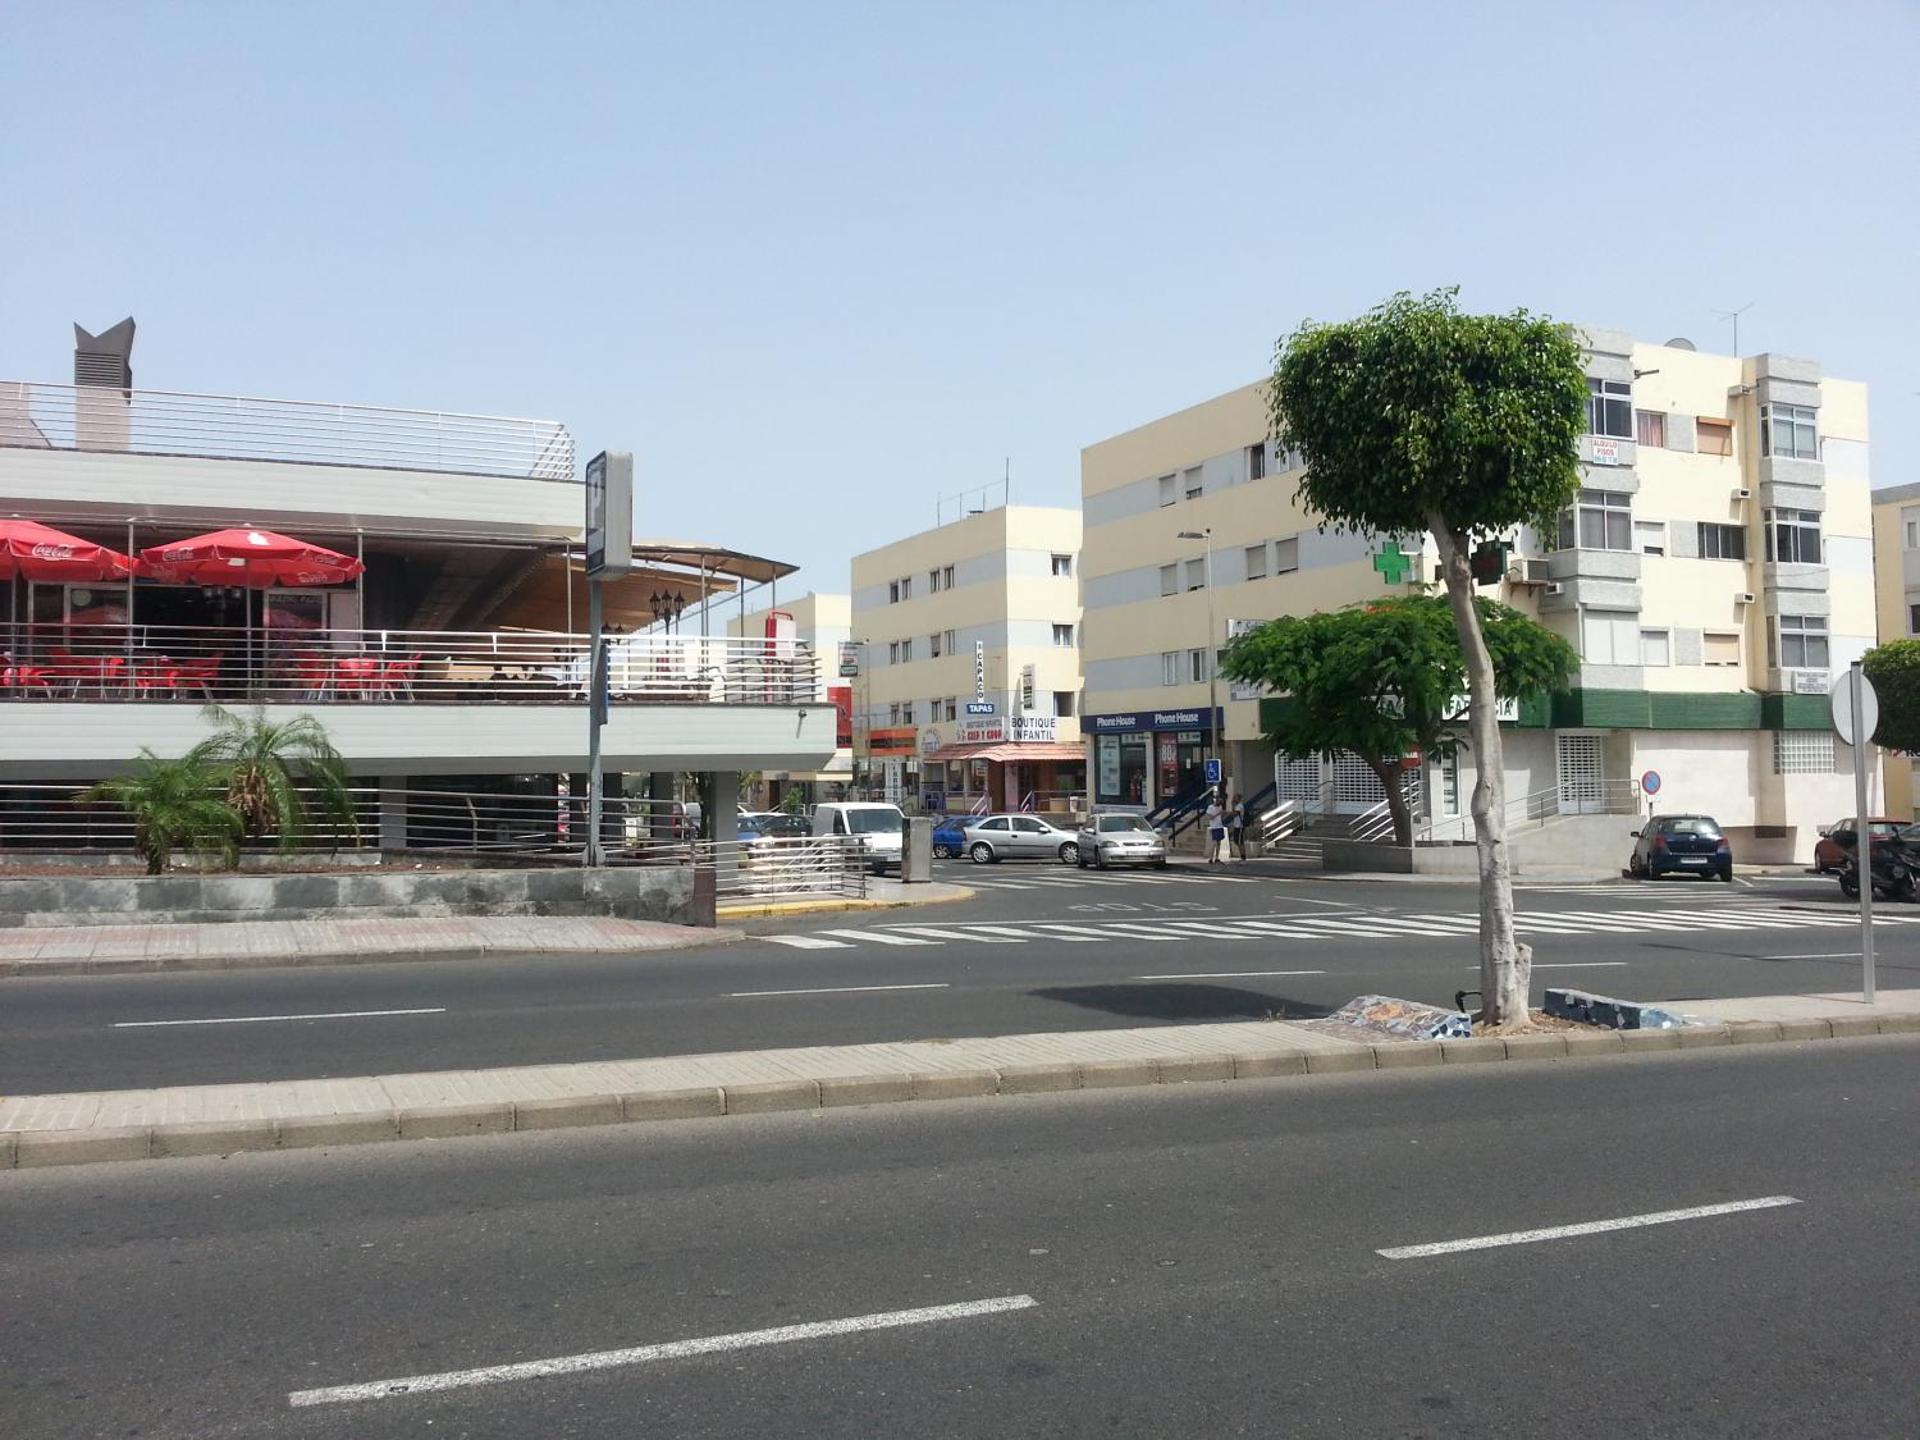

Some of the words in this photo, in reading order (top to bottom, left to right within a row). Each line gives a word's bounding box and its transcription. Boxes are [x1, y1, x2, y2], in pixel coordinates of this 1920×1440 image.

[969, 705, 993, 713] TAPAS
[1449, 699, 1512, 716] FARIA
[1012, 718, 1055, 728] BOUTIQUE
[1097, 717, 1116, 727] Phone
[1116, 716, 1136, 726] House
[1155, 713, 1176, 724] Phone
[1176, 712, 1199, 722] House
[1014, 730, 1054, 740] INFANTIL
